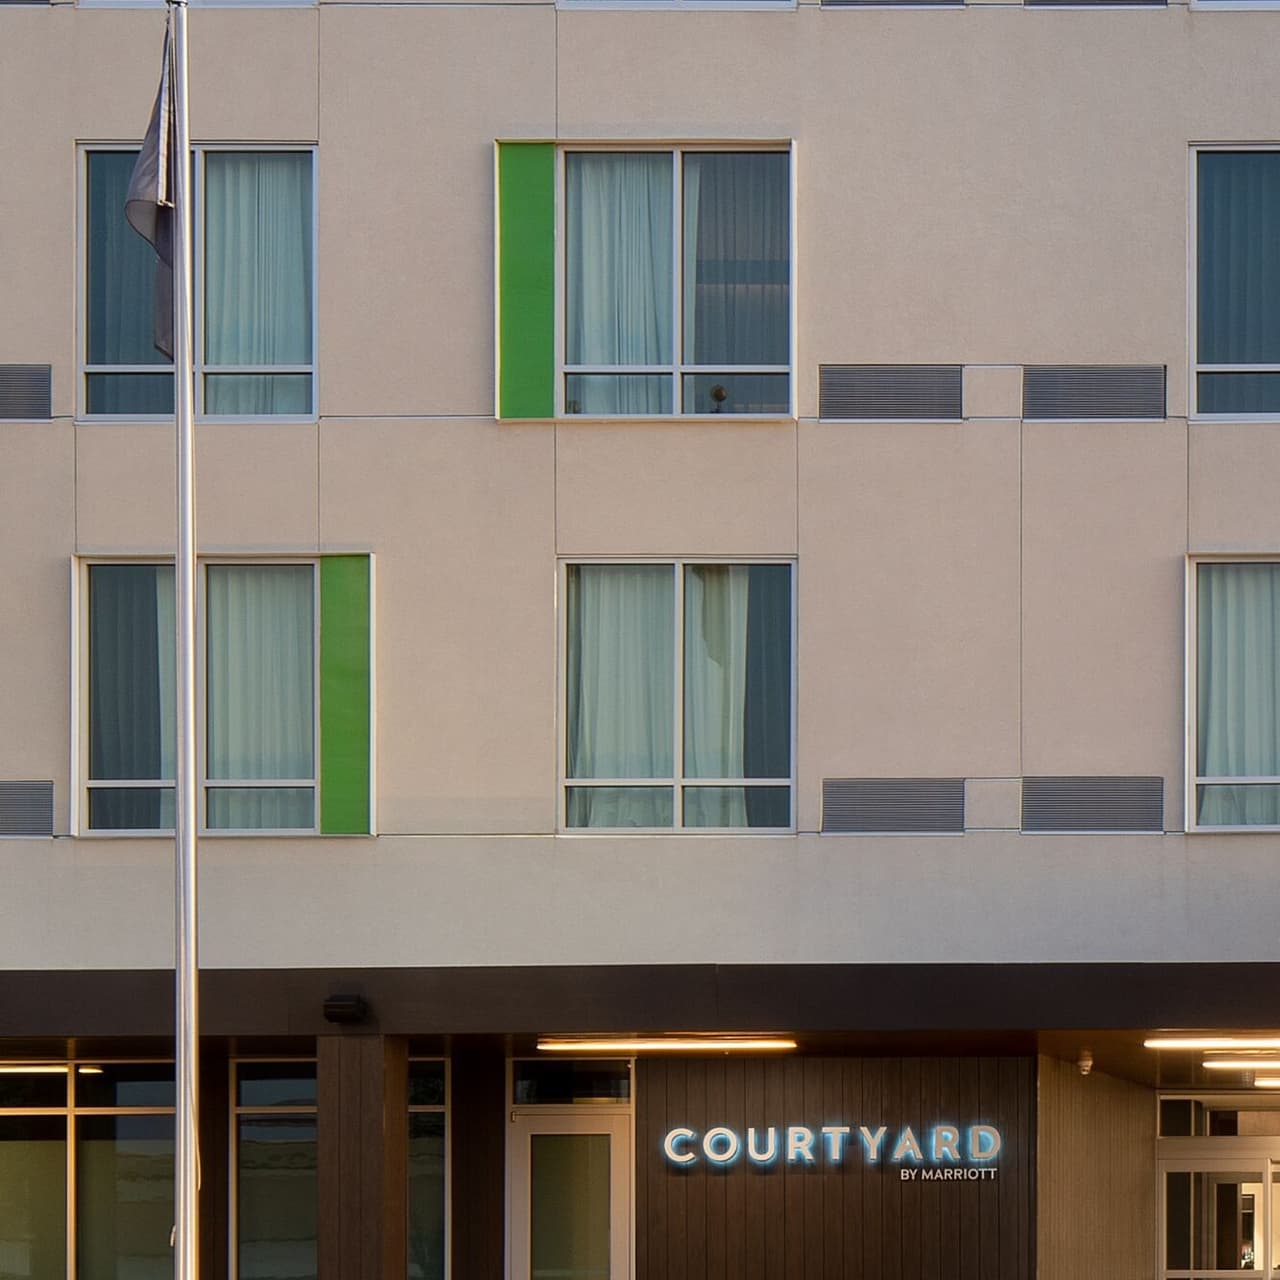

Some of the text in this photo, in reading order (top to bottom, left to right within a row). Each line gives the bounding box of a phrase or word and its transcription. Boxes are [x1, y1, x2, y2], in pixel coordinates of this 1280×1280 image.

[663, 1125, 1001, 1164] COURTYARD
[900, 1168, 997, 1180] BY MARRIOTT
